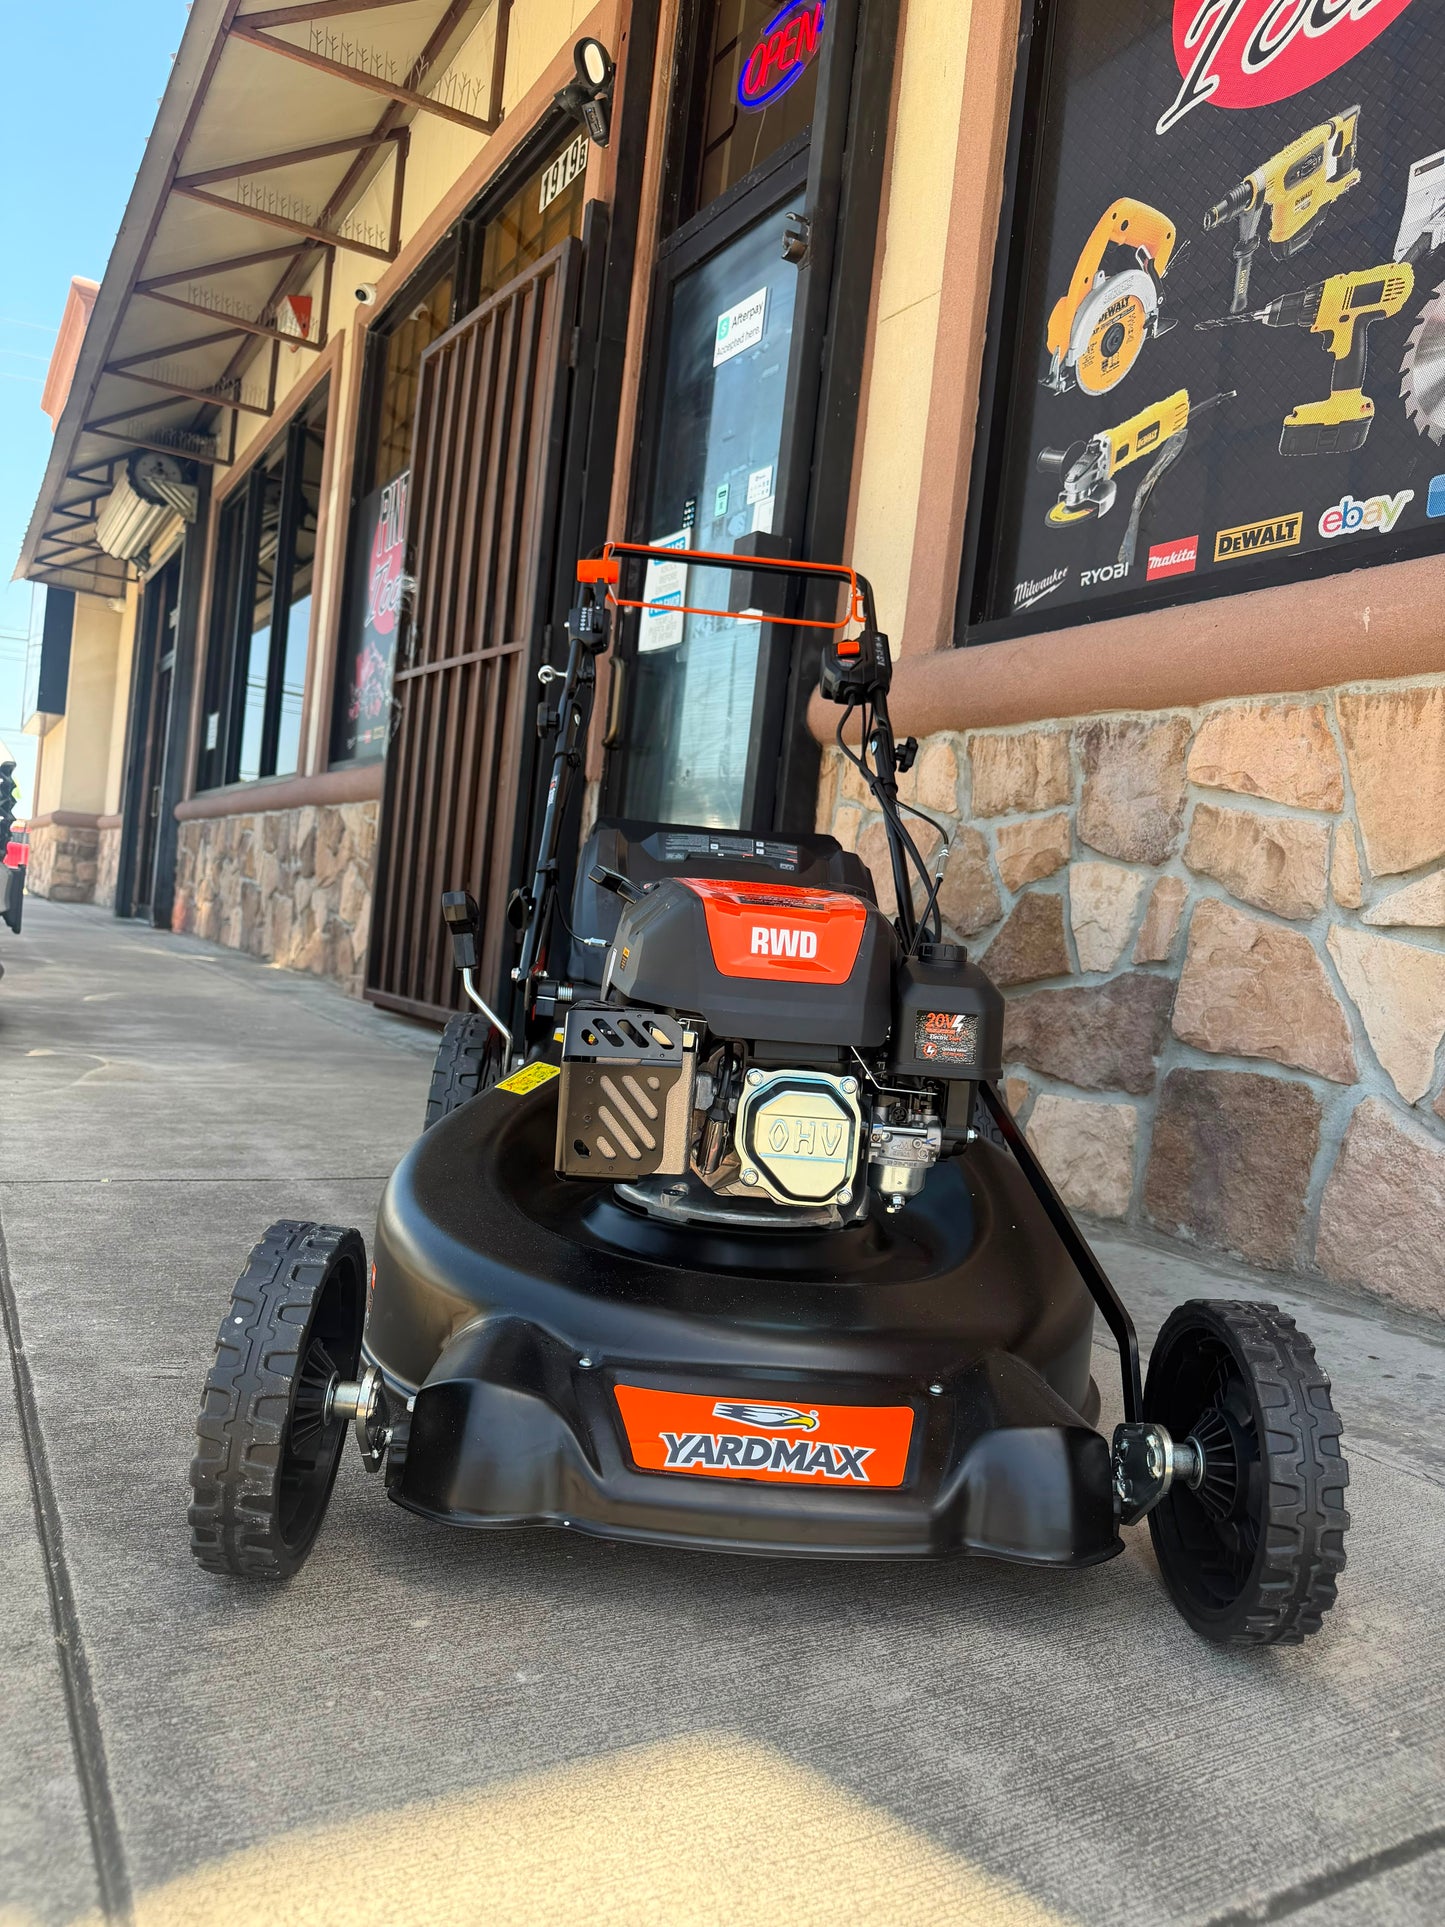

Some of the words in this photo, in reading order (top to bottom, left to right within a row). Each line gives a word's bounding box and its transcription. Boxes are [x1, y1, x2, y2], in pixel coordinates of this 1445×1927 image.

[744, 2, 821, 94] OPEN
[731, 302, 764, 328] Afterpay
[1321, 493, 1408, 533] ebay
[1013, 566, 1069, 605] Milwaukee
[1080, 561, 1129, 587] RYOBI
[750, 926, 817, 959] RWD
[925, 1012, 957, 1028] 20V
[768, 1118, 842, 1156] OHV
[658, 1431, 876, 1482] YARDMAX
